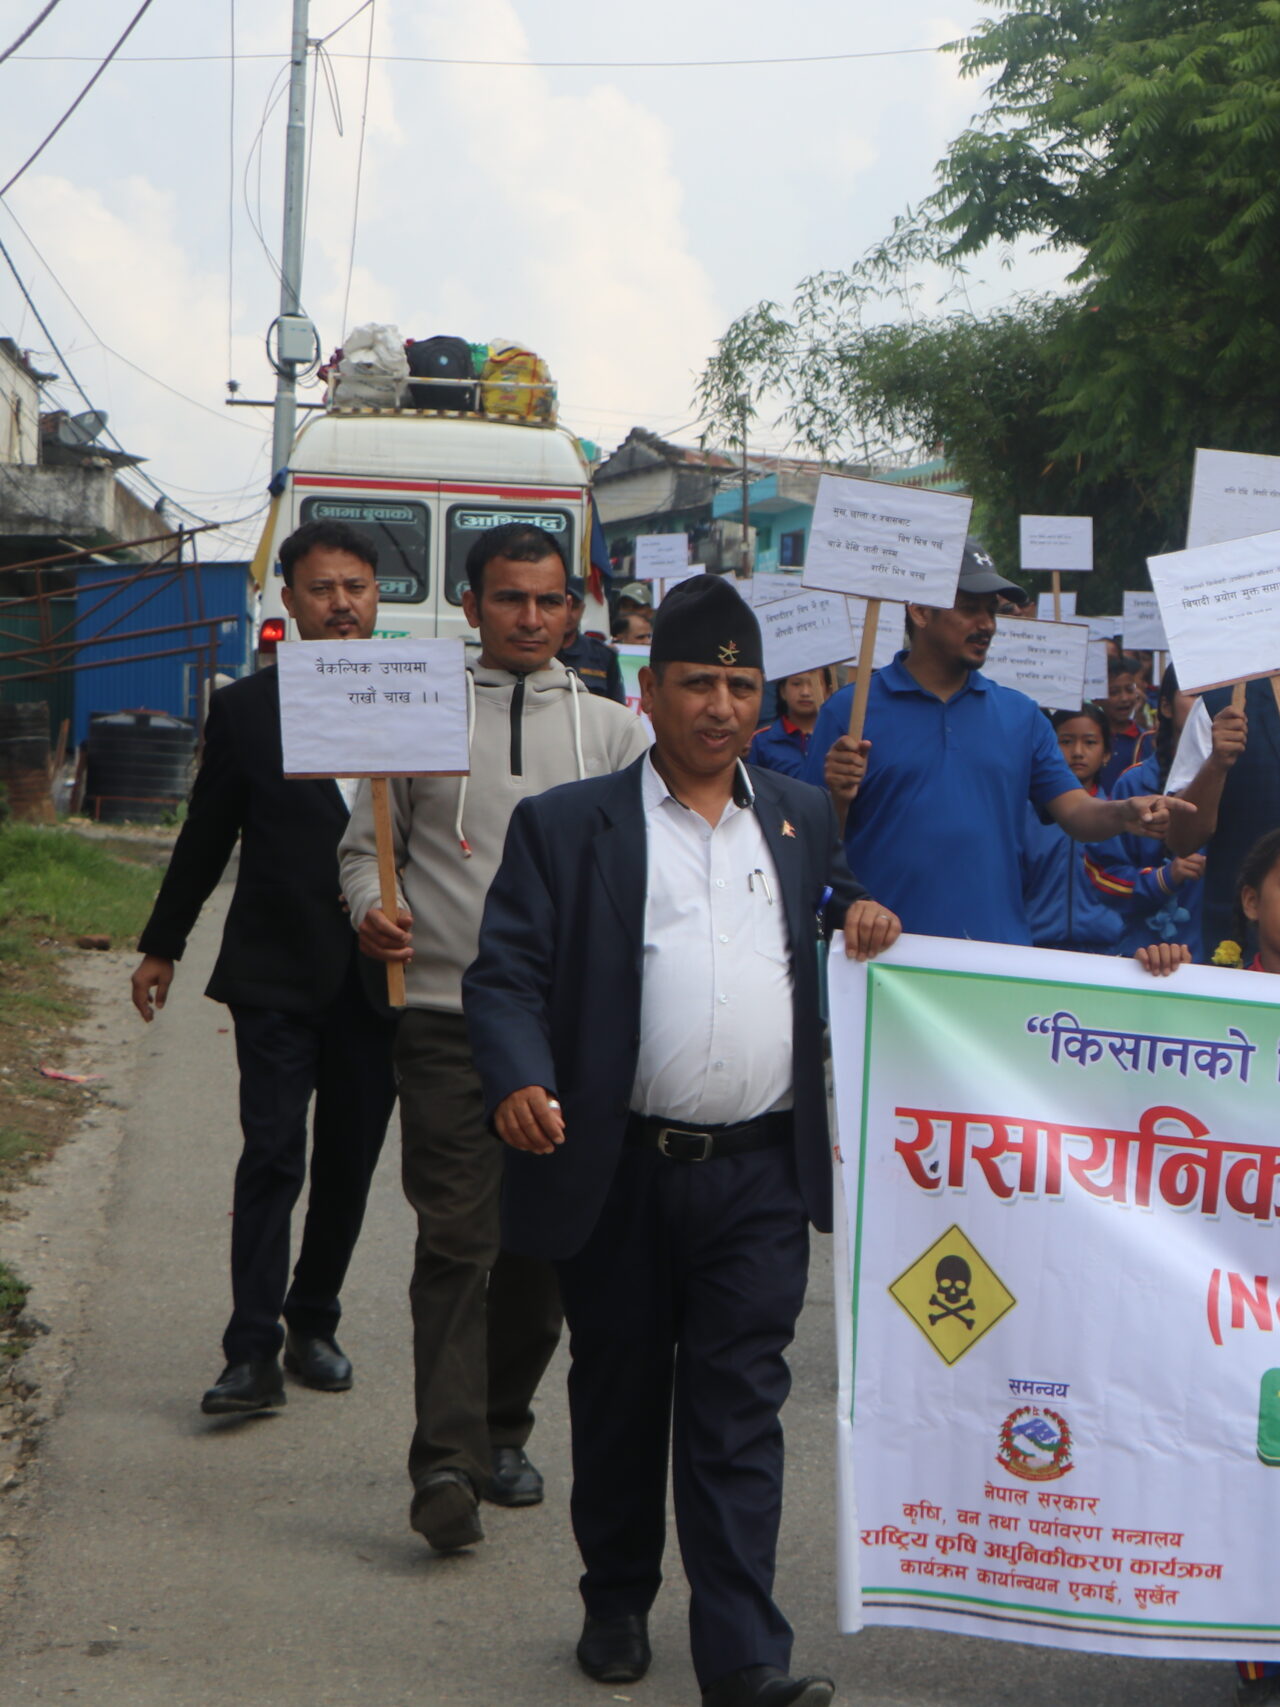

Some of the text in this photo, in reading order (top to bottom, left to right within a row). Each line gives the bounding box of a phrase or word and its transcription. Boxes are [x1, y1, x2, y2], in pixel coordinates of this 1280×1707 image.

[1214, 590, 1237, 604] प्रयोग
[1242, 586, 1260, 601] मुक्त
[315, 657, 427, 675] वैकल्पिक उपायमा
[384, 691, 411, 704] चाख
[1027, 1012, 1256, 1082] “किसानको
[1008, 1378, 1069, 1398] समन्वय
[984, 1481, 1101, 1516] नेपाल सरकार
[902, 1499, 1184, 1548] कृषि, वन तथा पर्यावरण मन्त्रालय
[860, 1525, 929, 1551] राष्ट्रिय
[935, 1532, 977, 1556] कृषि
[1130, 1556, 1224, 1580] कार्यक्रम
[900, 1556, 969, 1581] कार्यक्रम
[976, 1567, 1060, 1594] कार्यान्वयन
[1134, 1584, 1180, 1610] सुर्खेत
